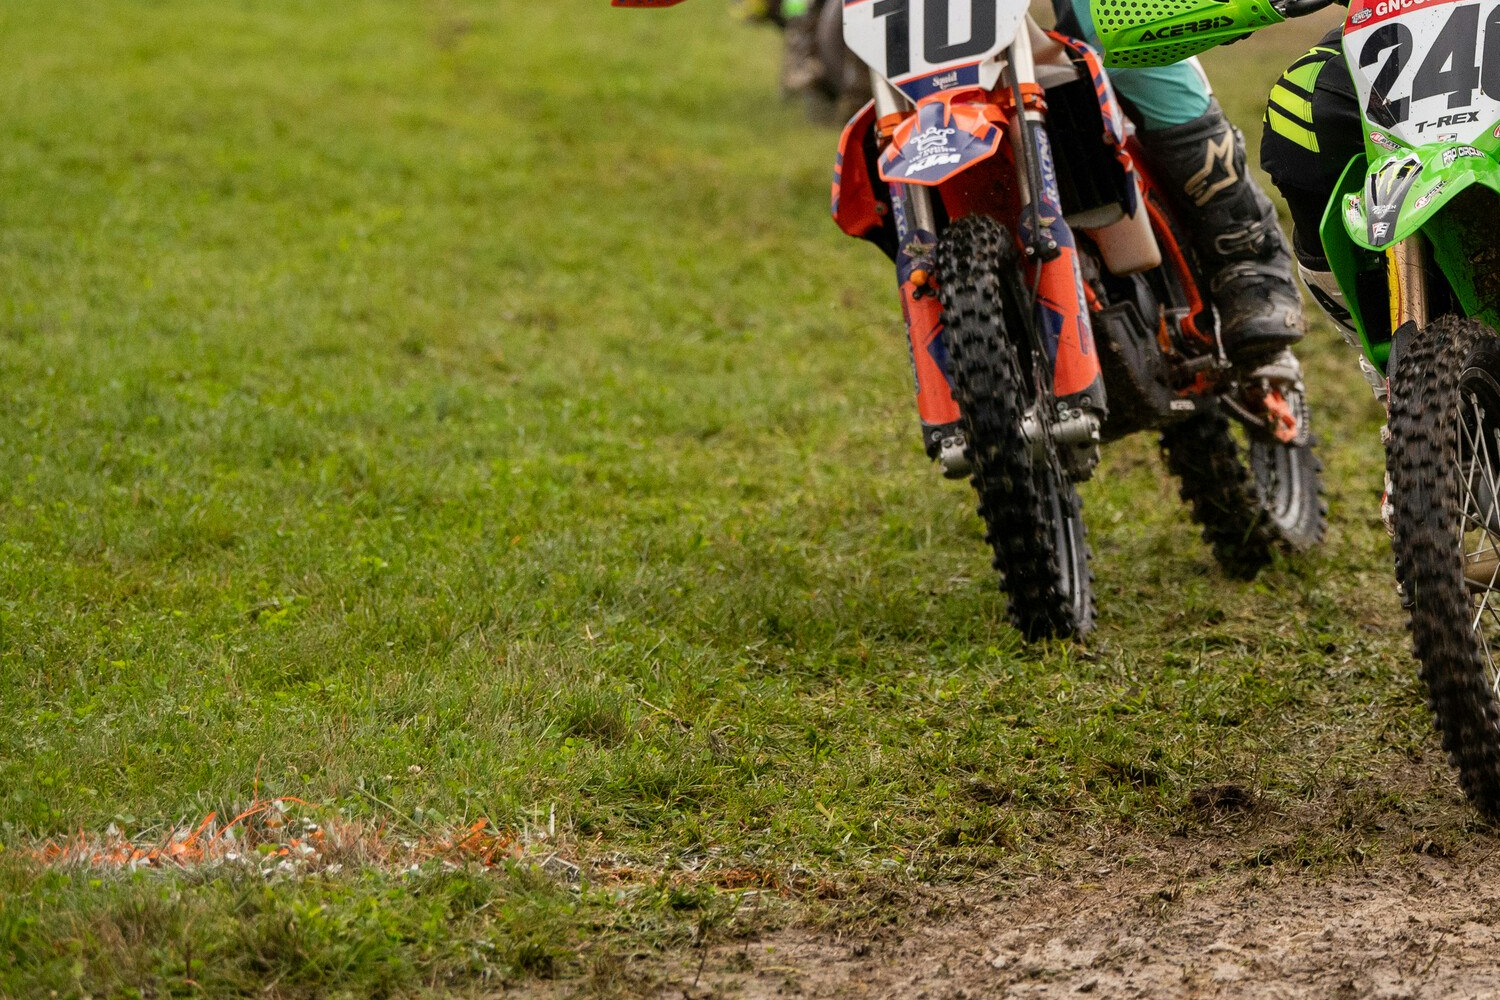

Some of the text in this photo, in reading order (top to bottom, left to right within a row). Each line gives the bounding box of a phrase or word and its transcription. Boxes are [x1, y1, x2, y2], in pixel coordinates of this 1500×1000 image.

[1415, 110, 1481, 134] T-REX
[905, 153, 962, 177] KTM
[1442, 146, 1458, 167] PRO
